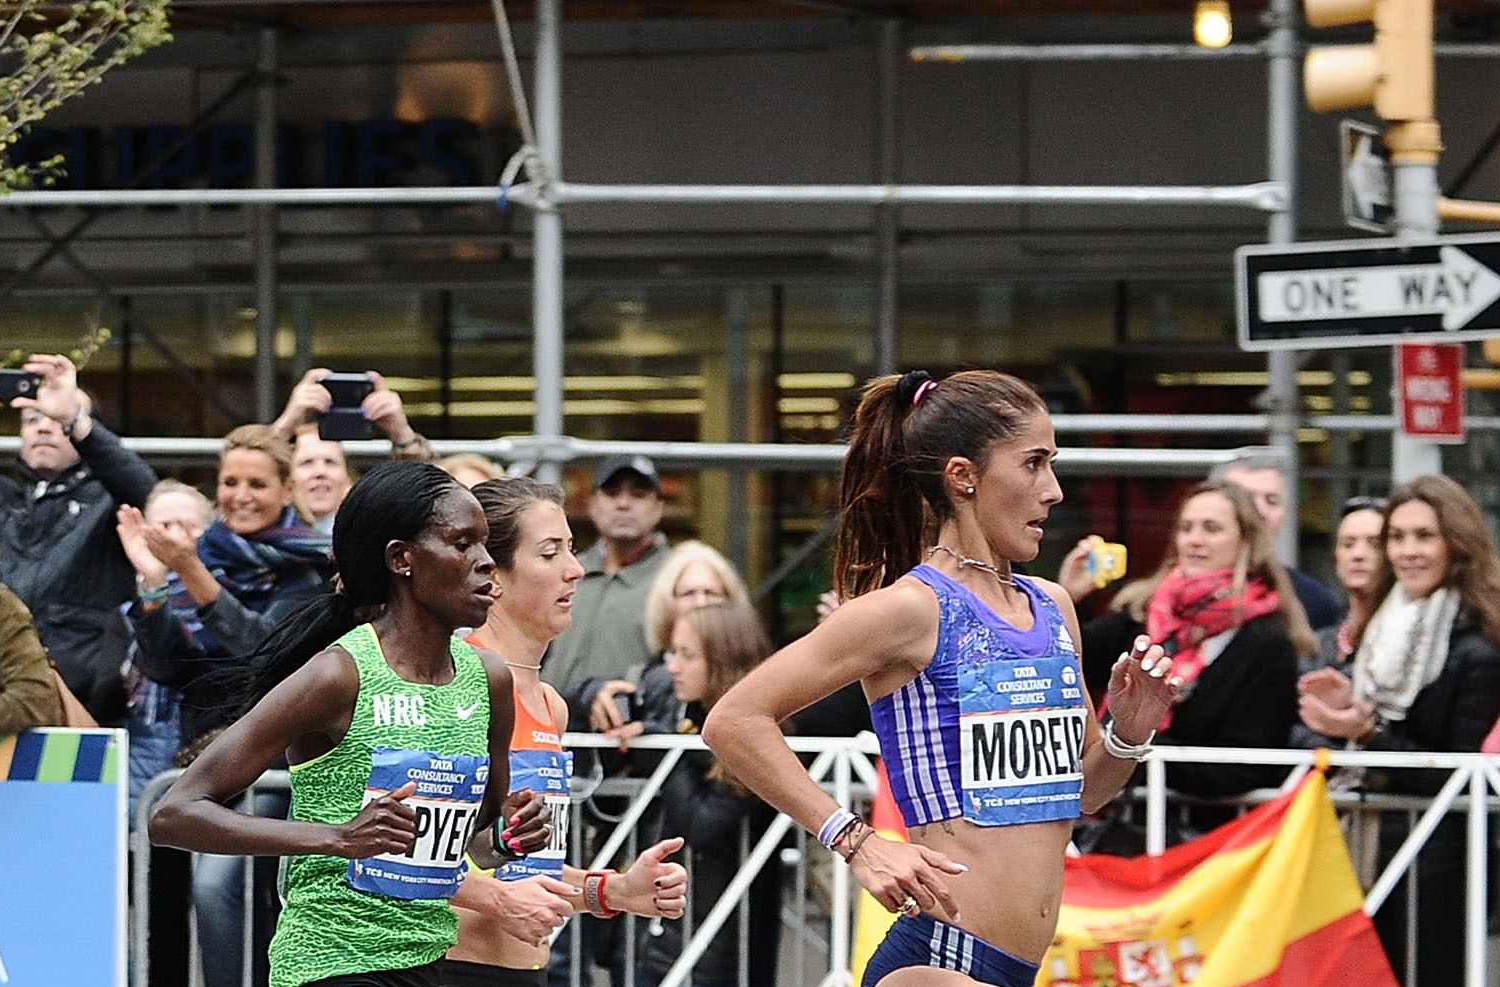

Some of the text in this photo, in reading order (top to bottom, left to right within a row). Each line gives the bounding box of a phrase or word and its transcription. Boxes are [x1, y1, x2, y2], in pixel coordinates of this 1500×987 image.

[1284, 270, 1478, 313] ONE WAY
[373, 694, 426, 727] NRC
[430, 759, 453, 770] TATA
[407, 769, 466, 785] CONSULTANCY
[417, 781, 454, 795] SERVICES
[985, 797, 1003, 808] TCS
[365, 867, 382, 878] TCS
[383, 871, 400, 881] NEW
